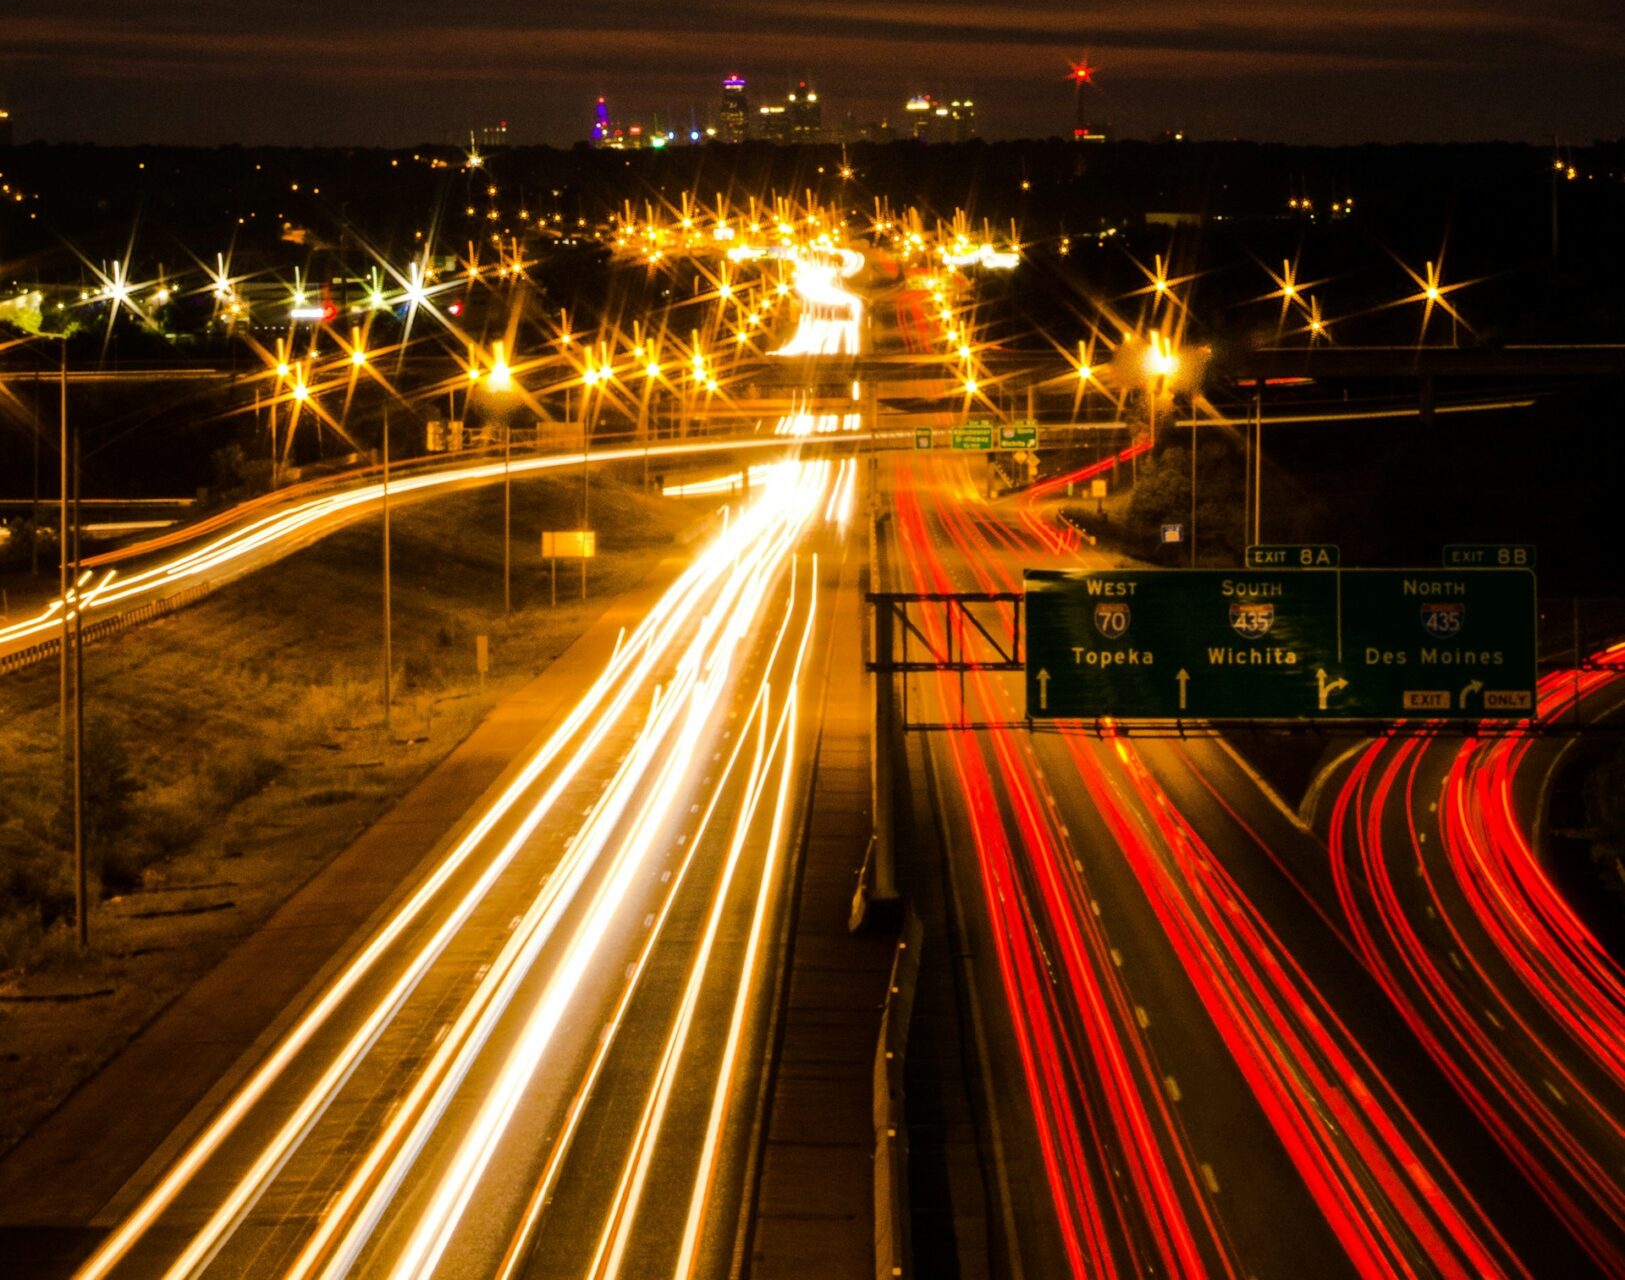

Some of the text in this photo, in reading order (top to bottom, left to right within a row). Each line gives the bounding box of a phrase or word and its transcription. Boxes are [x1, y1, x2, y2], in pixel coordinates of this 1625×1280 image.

[1254, 548, 1330, 565] EXIT 8A
[1451, 548, 1528, 565] EXIT 8B
[1086, 579, 1138, 596] WEST
[1221, 579, 1283, 597] SOUTH
[1402, 579, 1466, 596] NORTH
[1098, 612, 1126, 632] 70
[1232, 612, 1270, 632] 435
[1425, 612, 1461, 632] 435
[1072, 647, 1154, 669] Topeka
[1208, 647, 1298, 665] Wichita
[1365, 647, 1504, 665] Des Moines
[1410, 694, 1527, 706] EXIT ONLY
